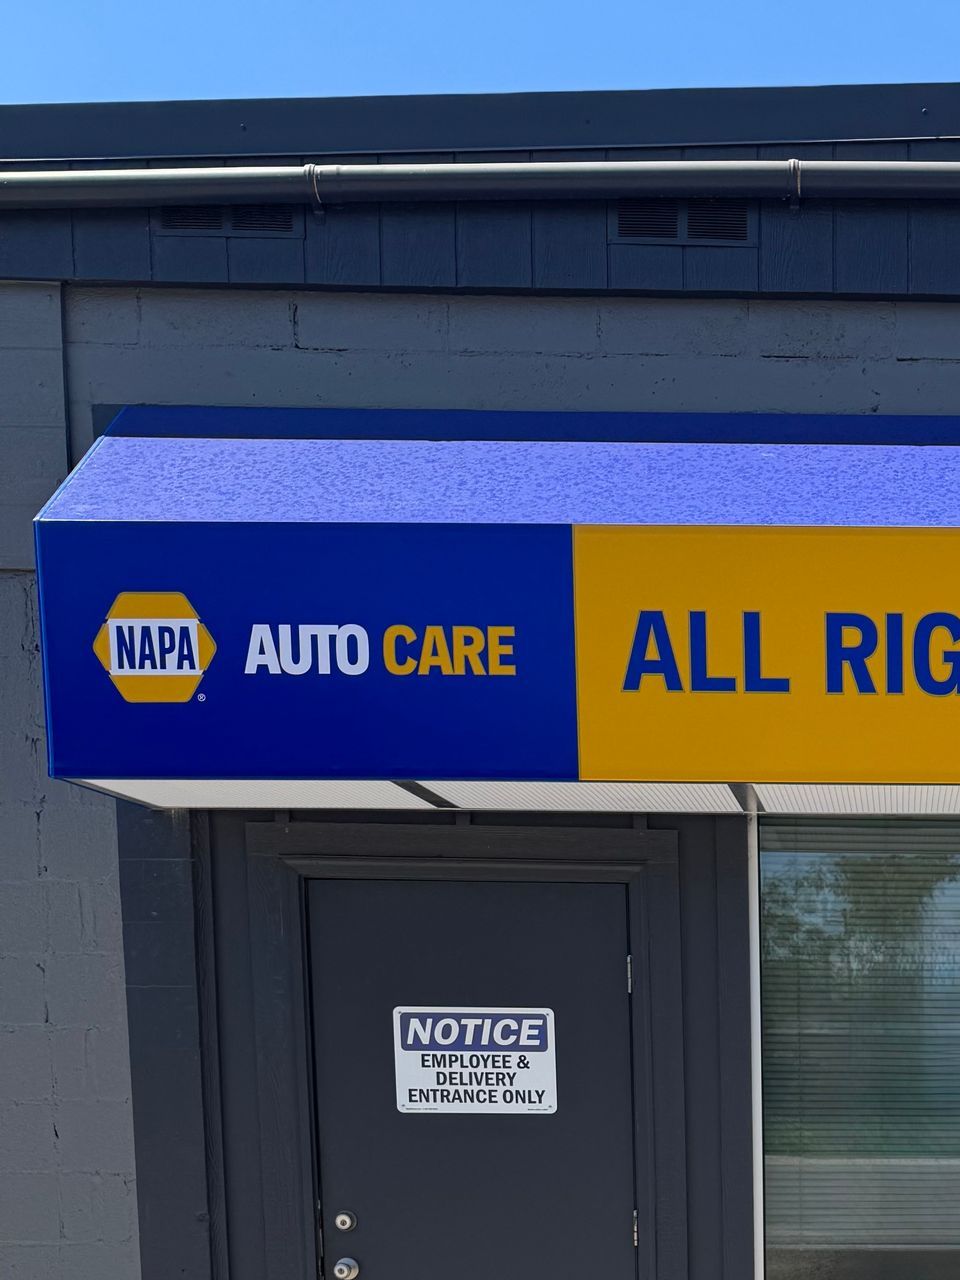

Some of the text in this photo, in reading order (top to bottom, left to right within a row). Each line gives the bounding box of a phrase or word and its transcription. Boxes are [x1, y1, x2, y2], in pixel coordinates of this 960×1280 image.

[115, 625, 196, 671] NAPA
[244, 623, 517, 676] AUTO CARE
[621, 609, 791, 695] ALL
[407, 1018, 543, 1046] NOTICE
[421, 1053, 530, 1069] EMPLOYEE &
[436, 1071, 516, 1086] DELIVERY
[408, 1089, 545, 1104] ENTRANCE ONLY
